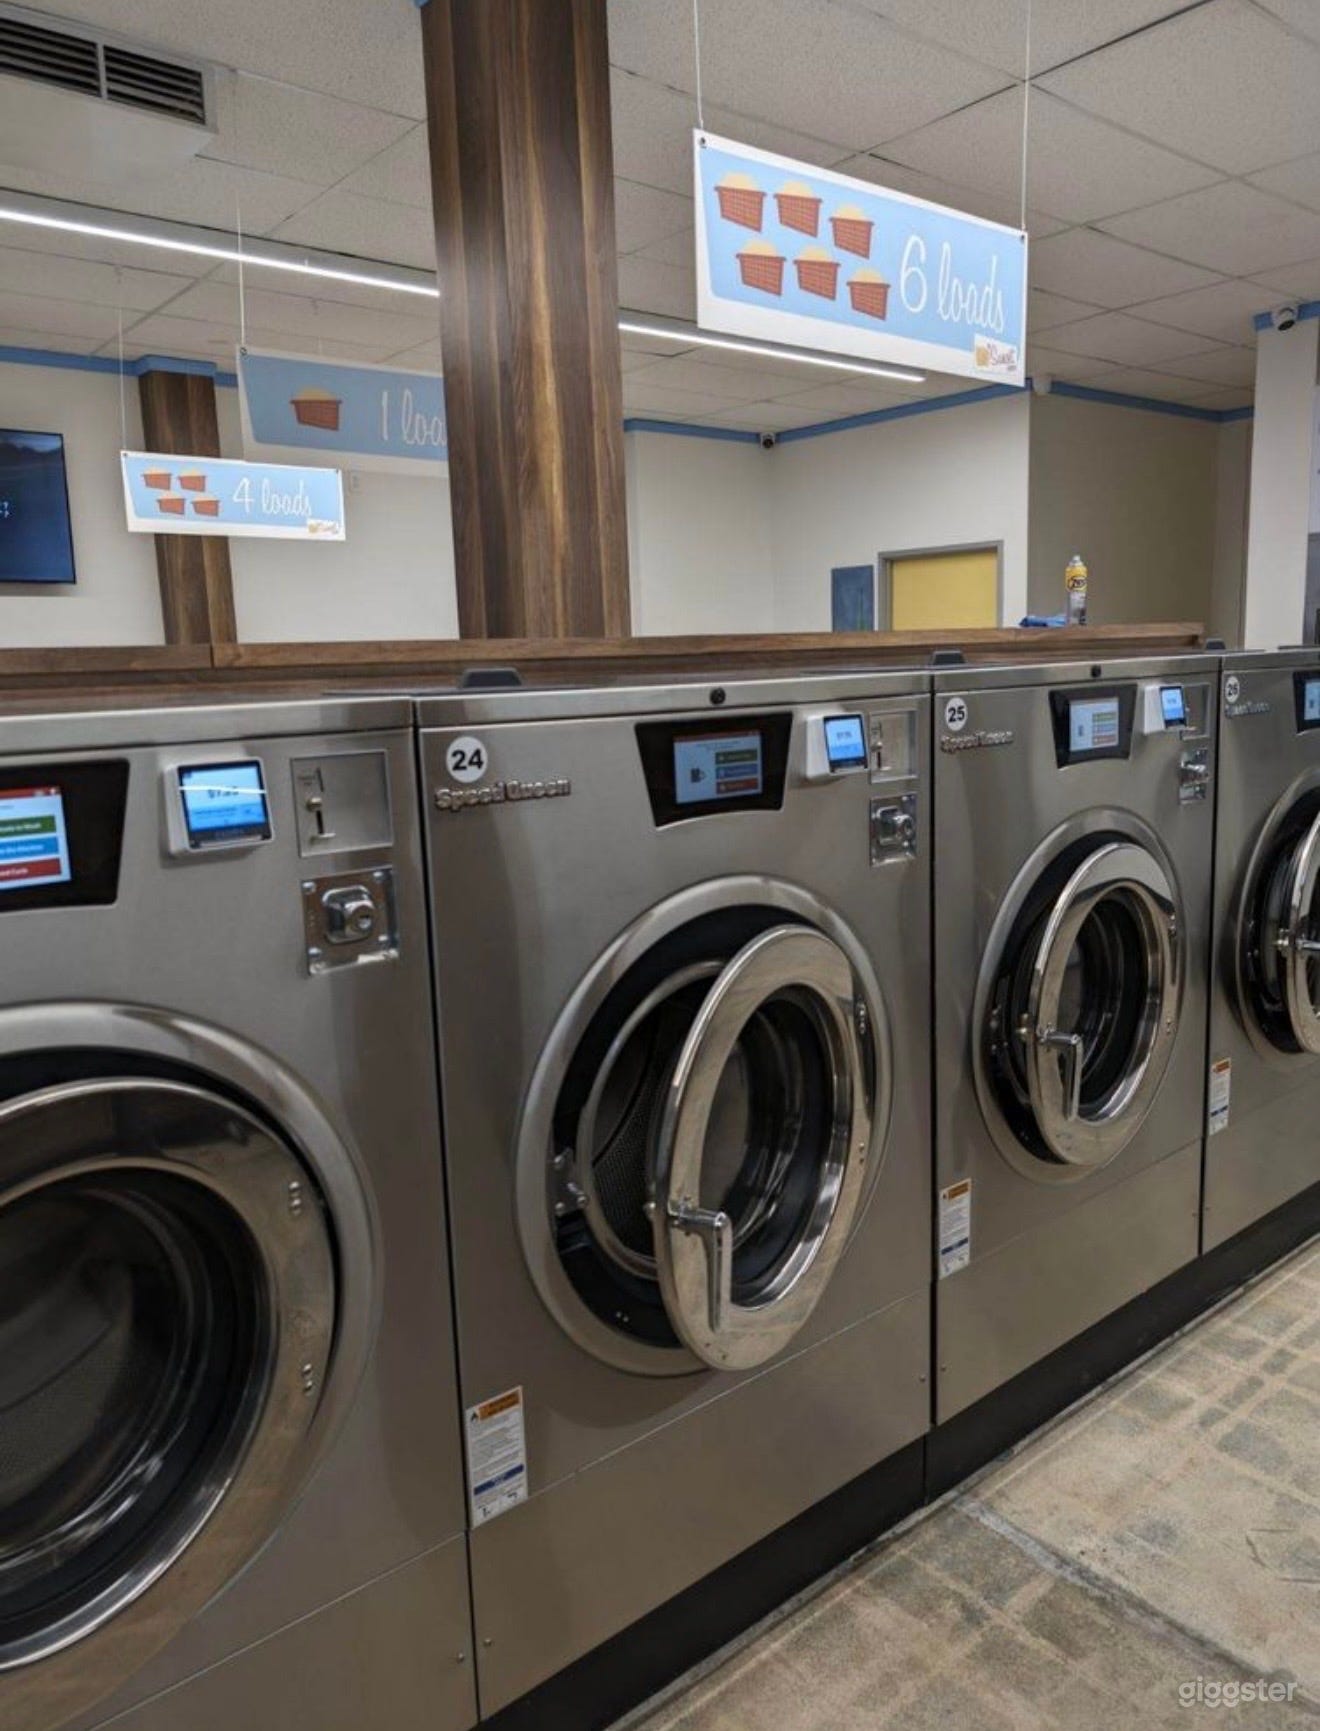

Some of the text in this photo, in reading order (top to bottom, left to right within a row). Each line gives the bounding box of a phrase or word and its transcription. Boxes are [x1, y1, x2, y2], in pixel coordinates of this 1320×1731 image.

[900, 234, 1004, 334] 6 loads
[382, 388, 447, 447] 1 loa
[232, 477, 312, 517] 4 loads
[947, 705, 965, 722] 25
[451, 747, 484, 771] 24
[434, 779, 571, 813] Speed Queen
